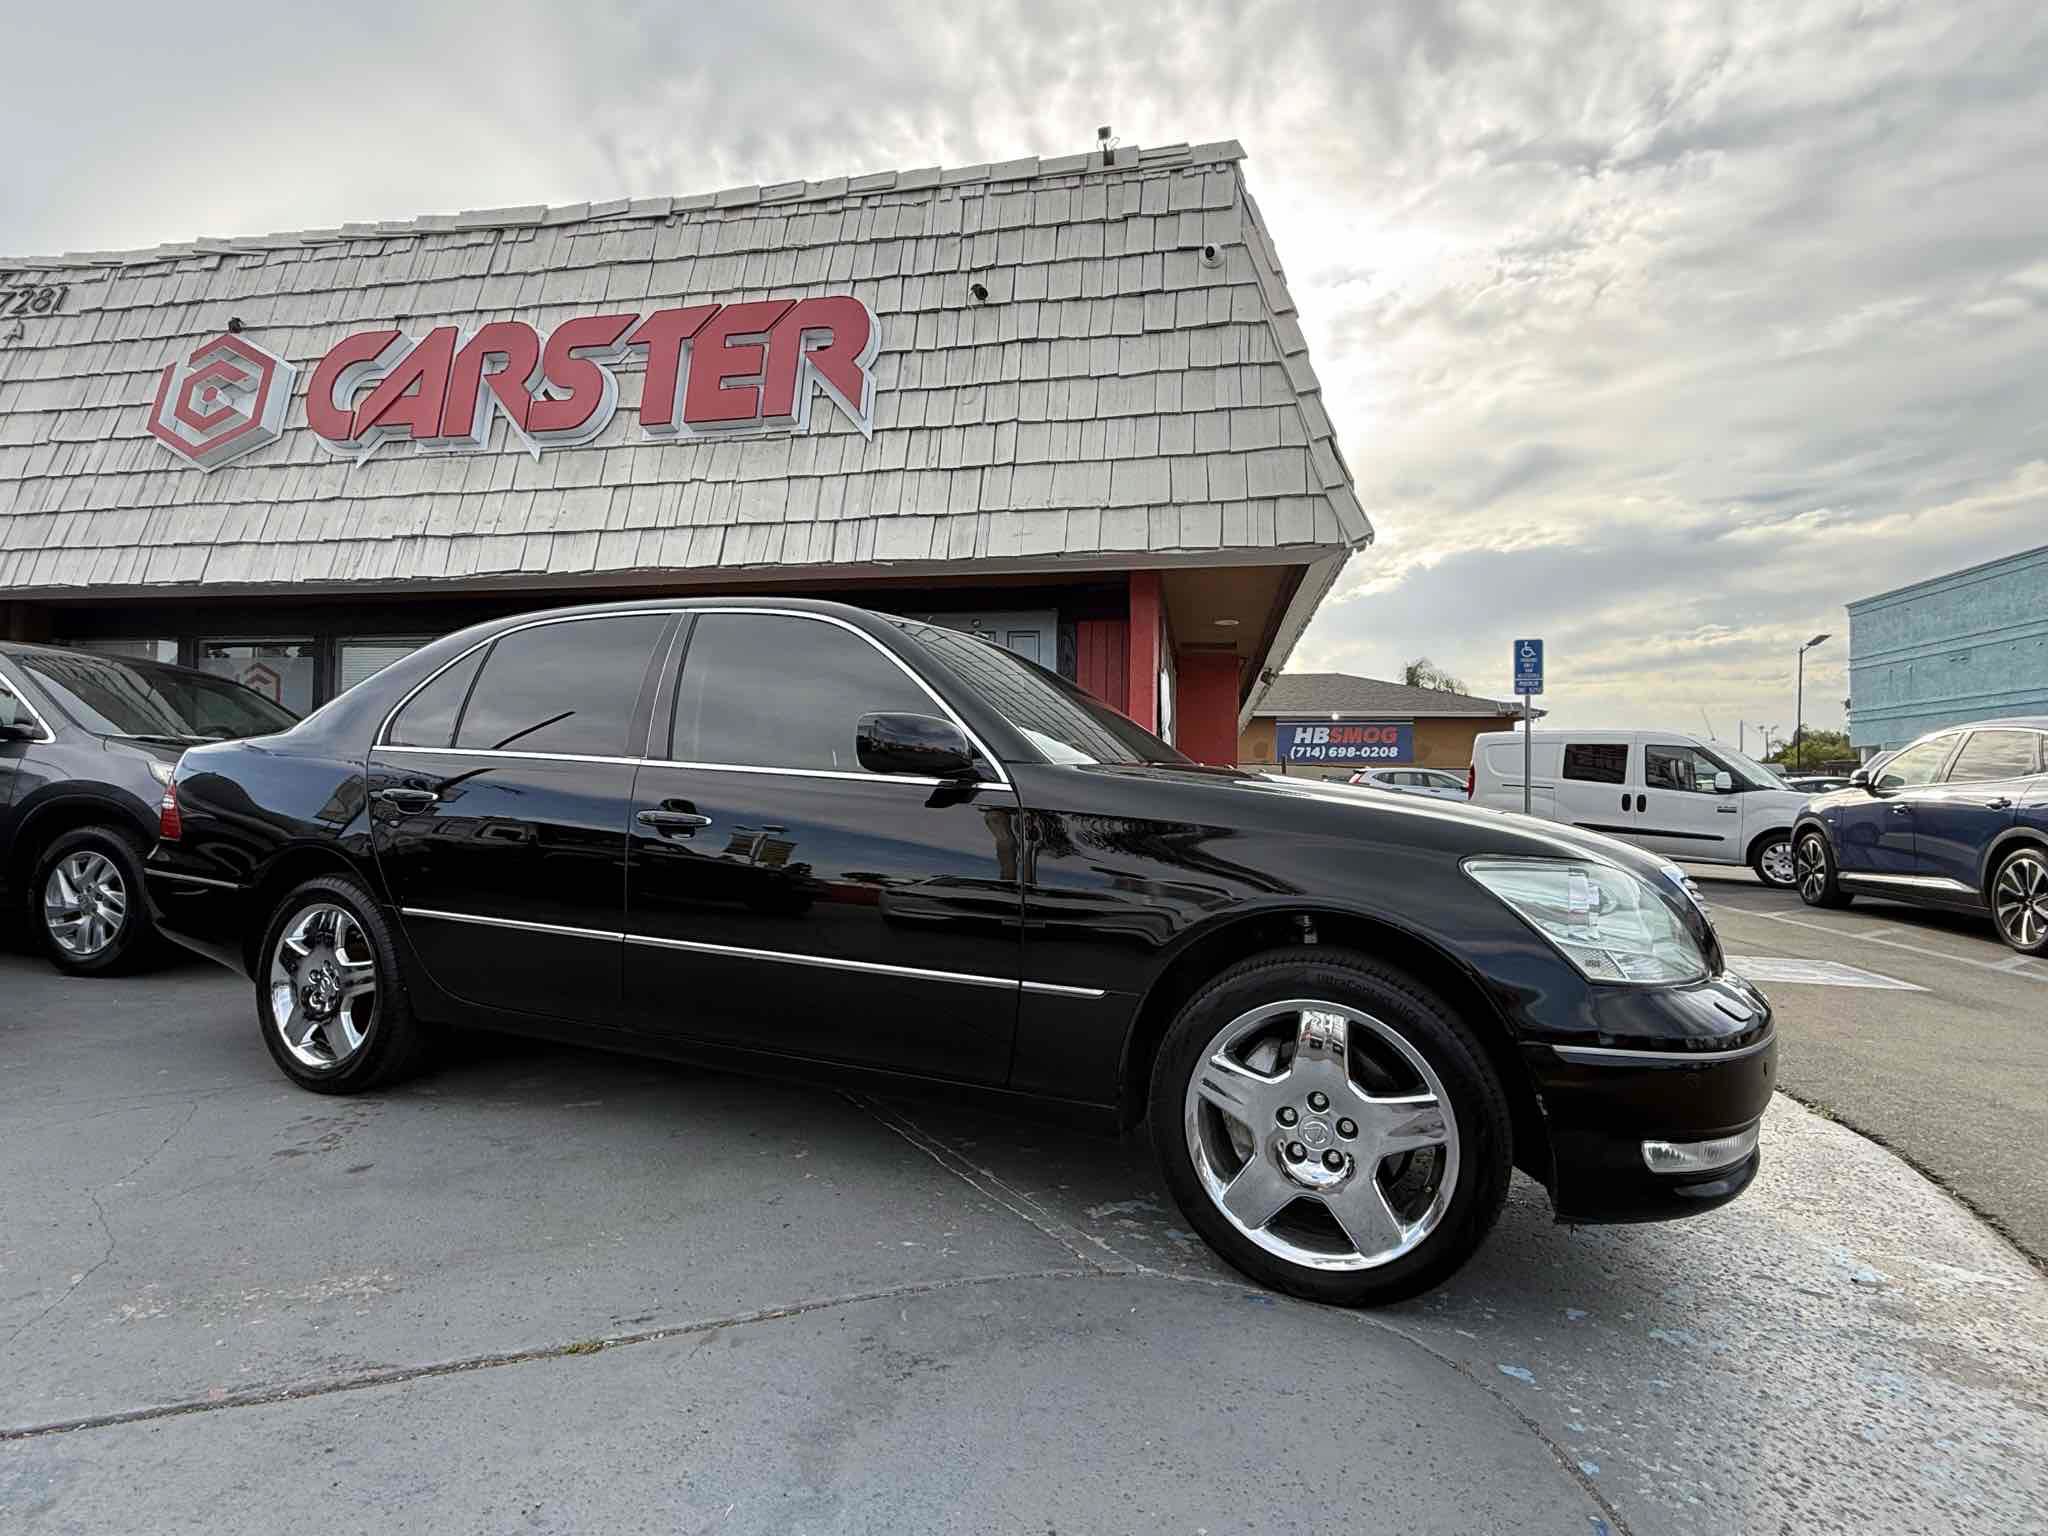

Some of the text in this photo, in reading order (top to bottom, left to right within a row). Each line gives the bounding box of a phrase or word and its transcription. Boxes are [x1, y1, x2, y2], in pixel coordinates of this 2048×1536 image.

[306, 295, 880, 456] CARSTER
[1290, 746, 1398, 759] (714) 698-0208
